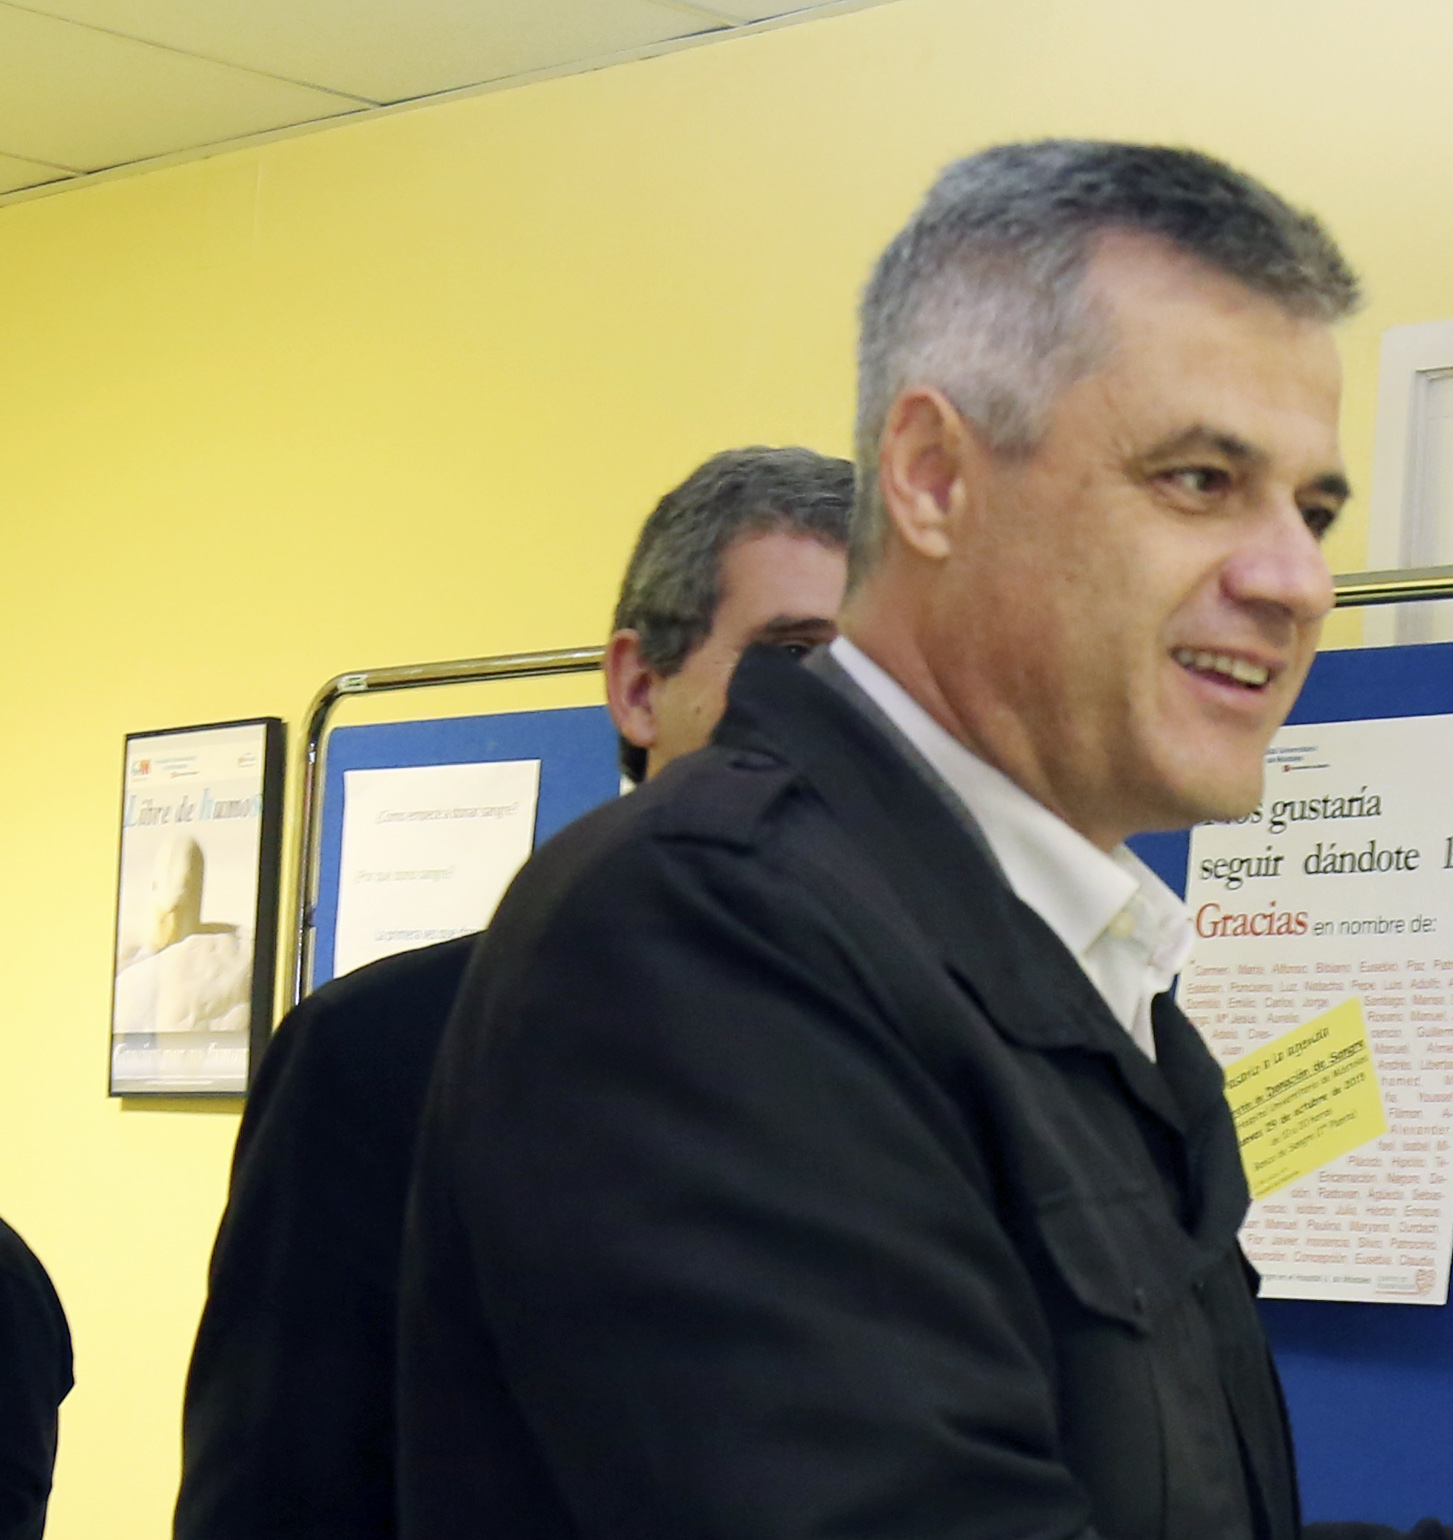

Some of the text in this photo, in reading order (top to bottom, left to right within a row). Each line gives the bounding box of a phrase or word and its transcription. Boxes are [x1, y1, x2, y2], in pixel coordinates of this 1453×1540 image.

[1268, 785, 1382, 834] gustaría
[1200, 845, 1284, 890] seguir
[1304, 840, 1421, 875] dándote
[1195, 901, 1438, 938] Gracias en nombre de:
